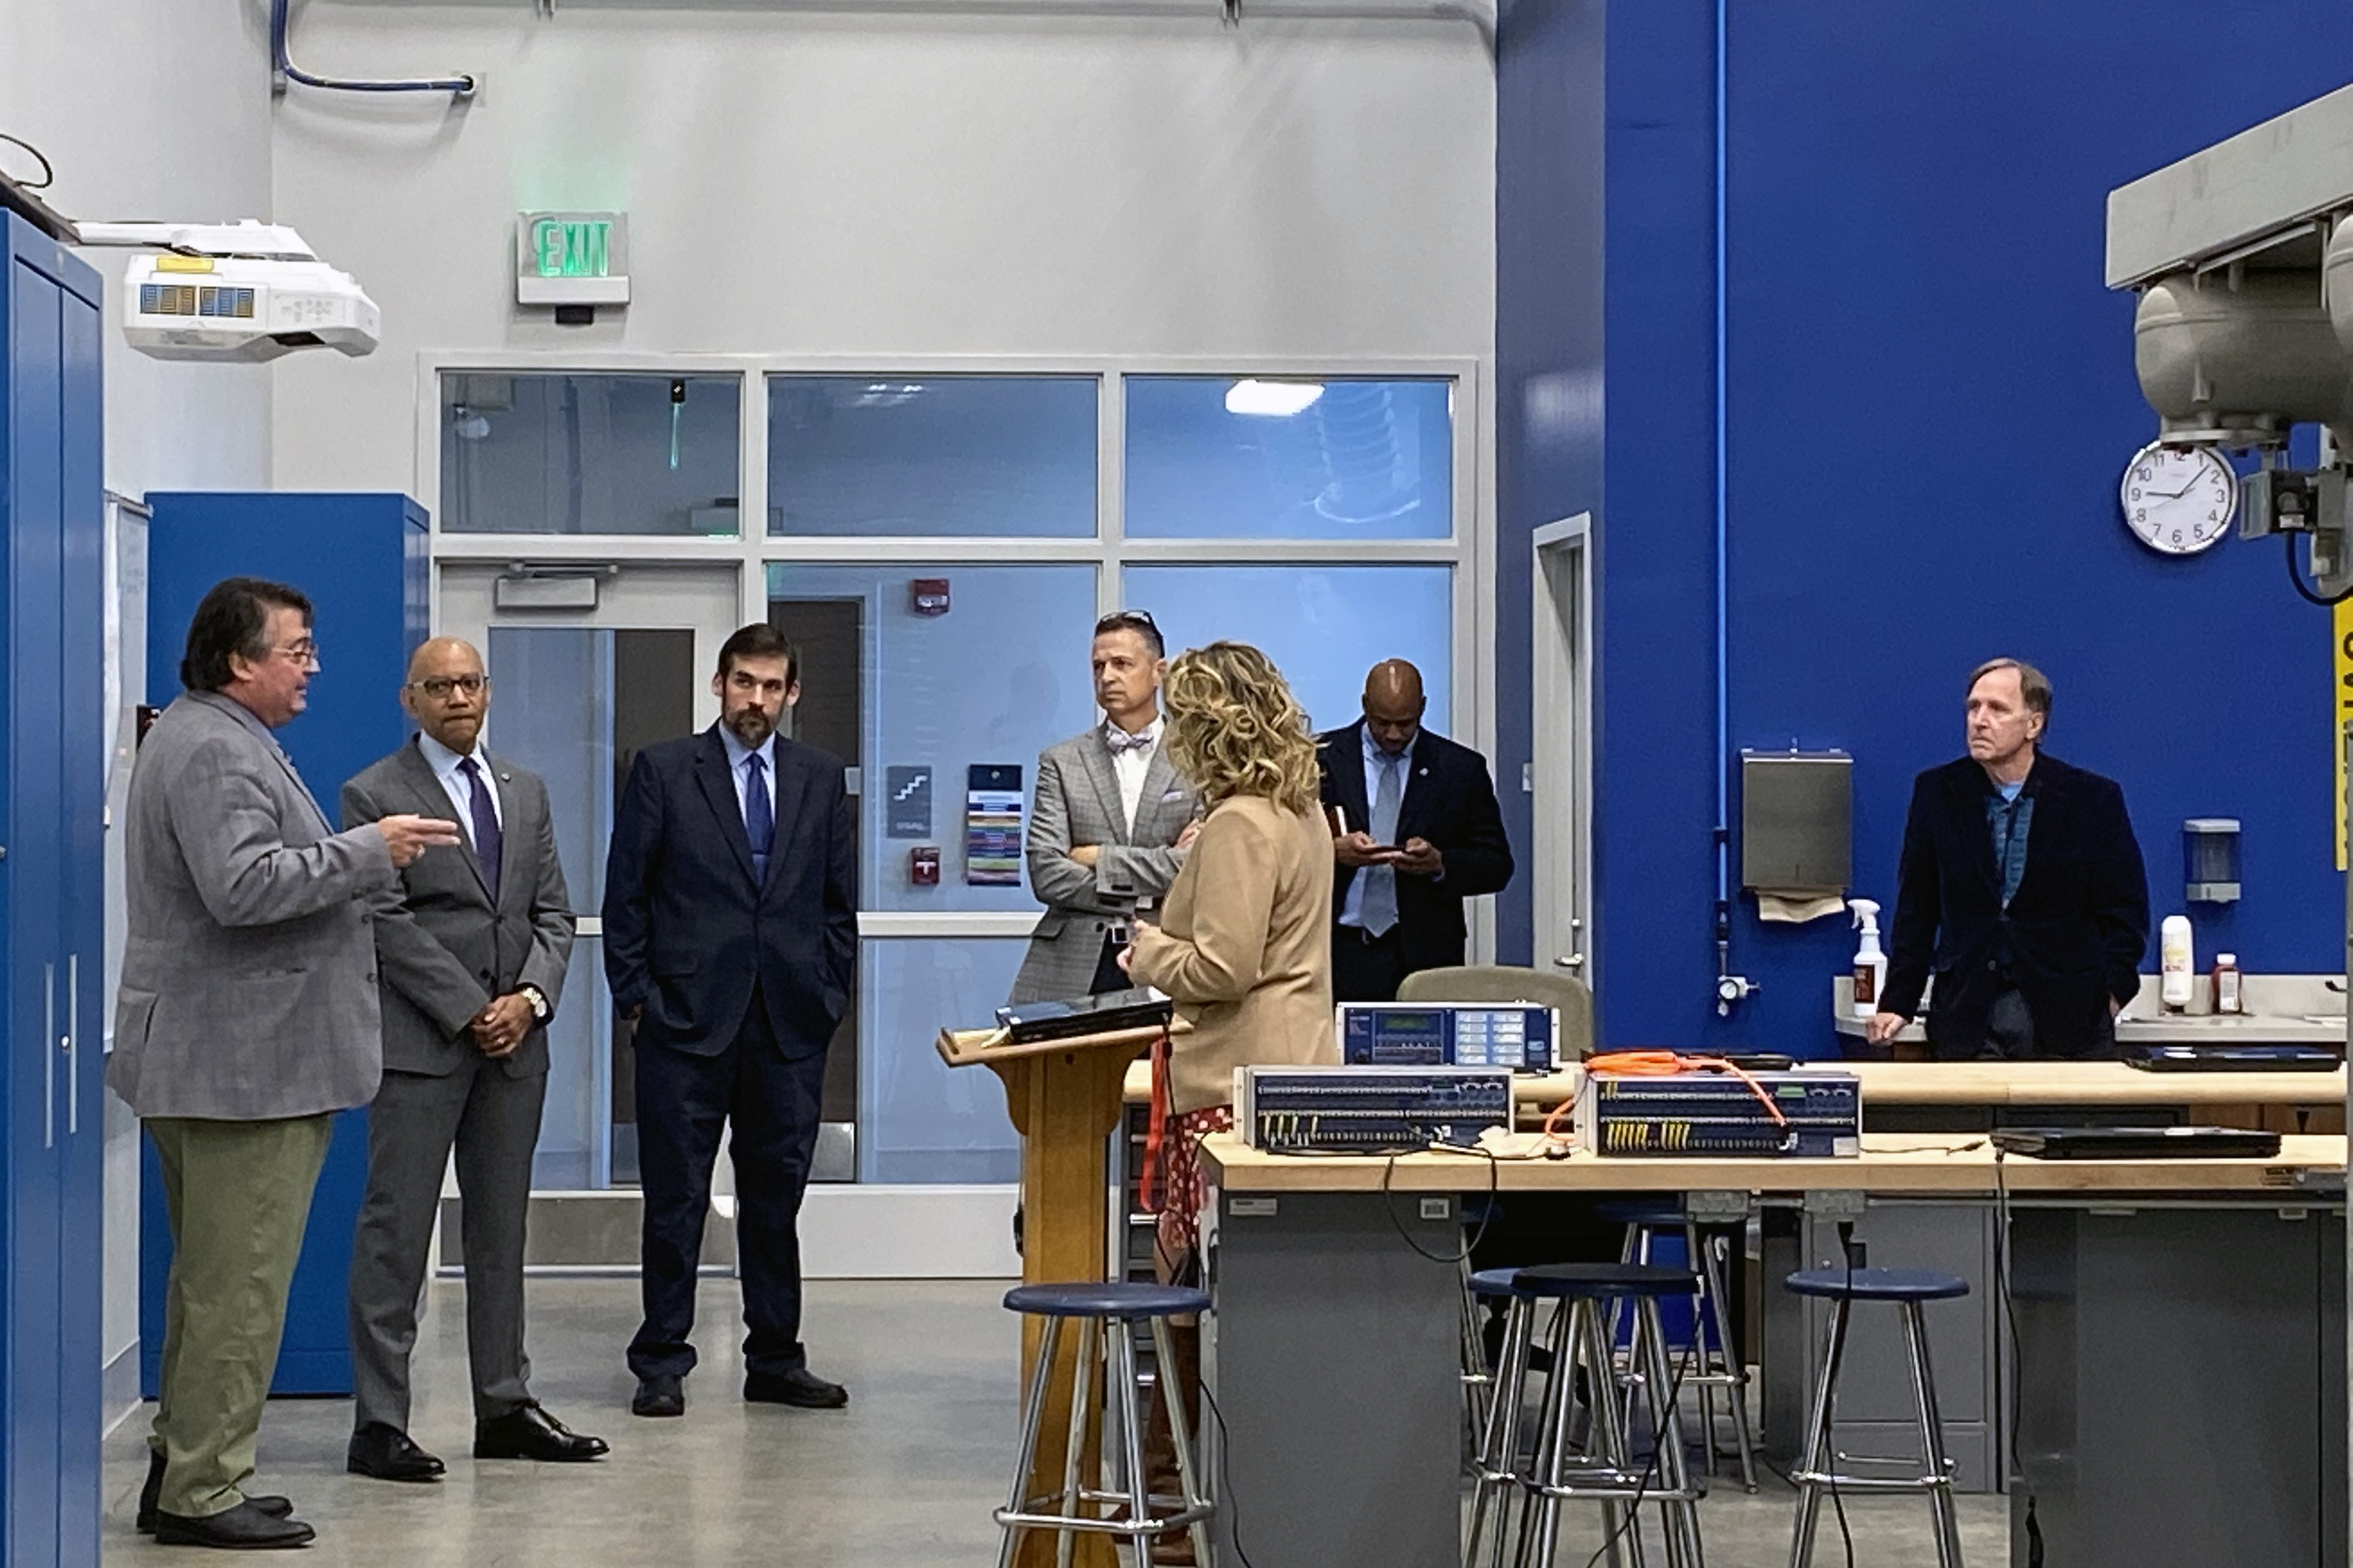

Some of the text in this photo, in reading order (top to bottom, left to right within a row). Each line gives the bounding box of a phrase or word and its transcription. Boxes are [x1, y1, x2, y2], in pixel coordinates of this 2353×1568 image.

[536, 221, 611, 277] EXIT
[2153, 453, 2165, 467] 11
[2198, 453, 2204, 467] 1
[2136, 467, 2152, 482] 10
[2210, 470, 2221, 484] 2
[2131, 488, 2141, 502] 9
[2216, 489, 2225, 503] 3
[2136, 508, 2146, 523] 8
[2208, 509, 2218, 521] 4
[2153, 523, 2162, 536] 7
[2172, 529, 2182, 543] 6
[2194, 524, 2204, 539] 5
